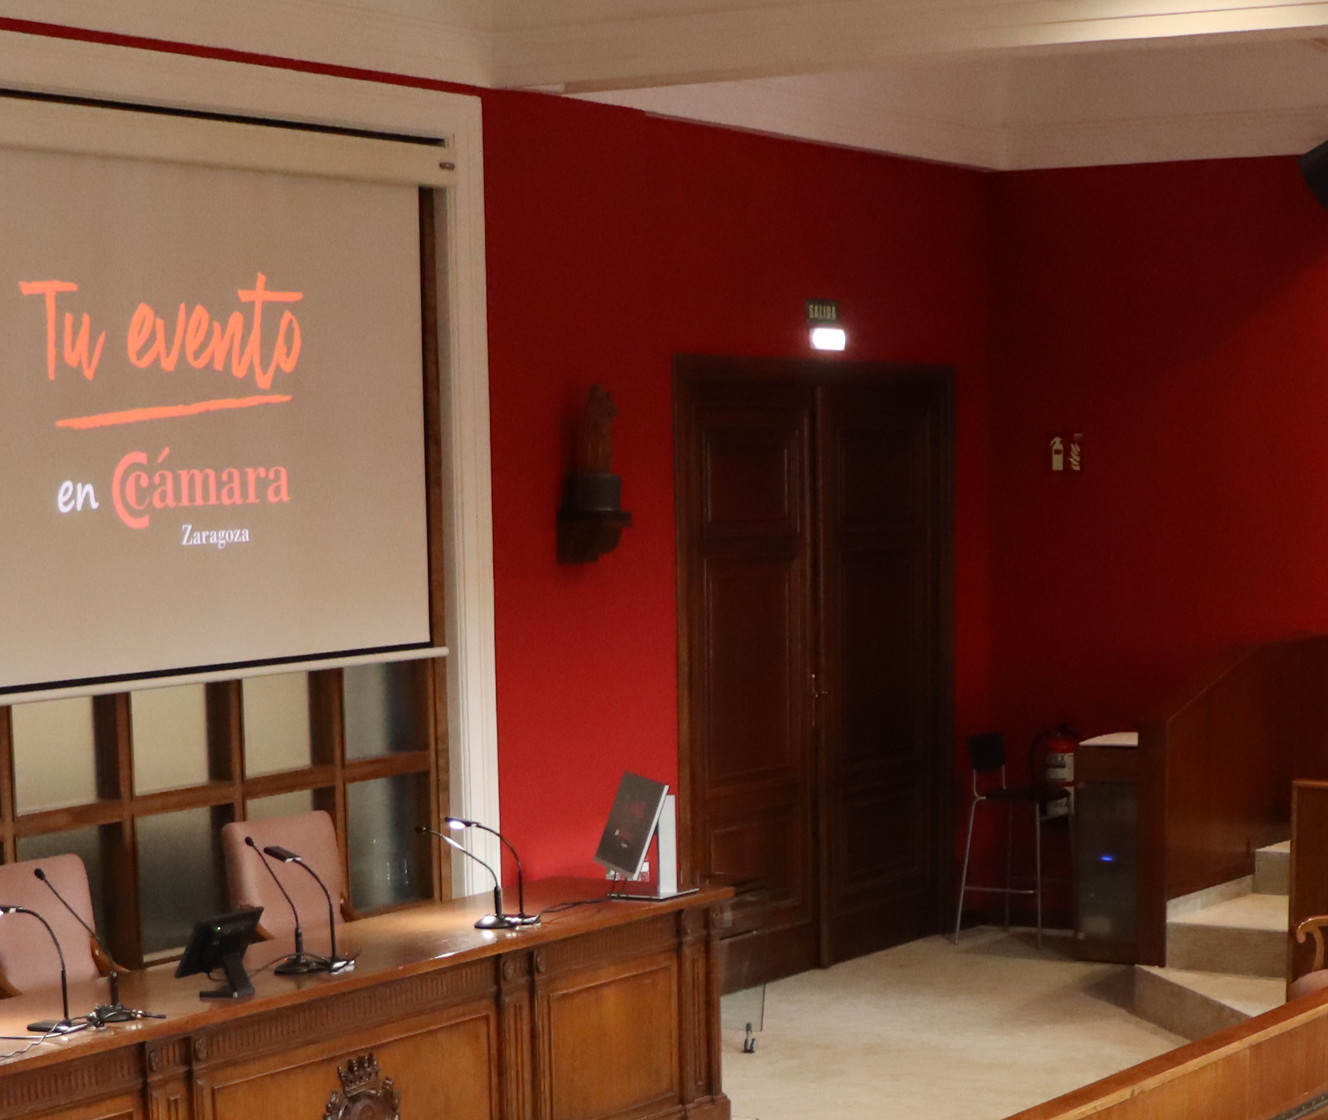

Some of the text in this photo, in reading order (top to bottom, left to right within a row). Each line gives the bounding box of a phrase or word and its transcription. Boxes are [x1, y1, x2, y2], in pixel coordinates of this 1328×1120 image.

[18, 271, 304, 390] Tu evento
[57, 480, 100, 514] en
[181, 524, 250, 549] Zaragoza
